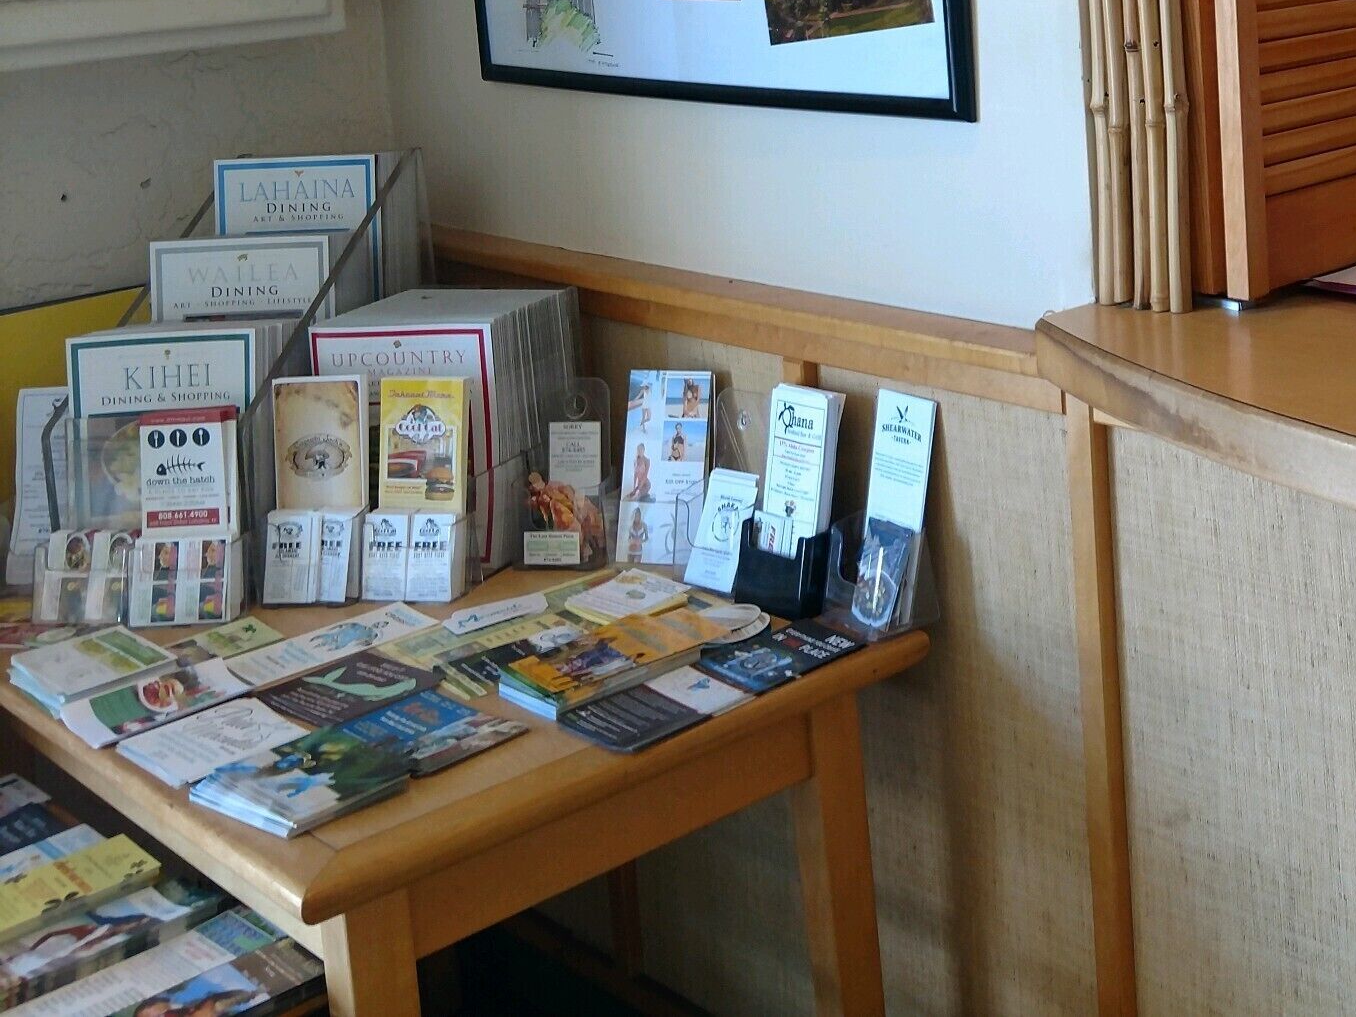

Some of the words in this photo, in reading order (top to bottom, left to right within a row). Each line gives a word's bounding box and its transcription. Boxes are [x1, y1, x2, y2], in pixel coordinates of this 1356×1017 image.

[239, 178, 356, 203] LAHAINA
[266, 201, 332, 214] DINING
[253, 214, 273, 223] ART
[278, 214, 286, 222] &
[290, 213, 345, 221] SHOPPING
[187, 262, 298, 284] WAILEA
[211, 285, 279, 299] DINING
[331, 349, 467, 368] UPCOUNTRY
[122, 362, 211, 391] KIHEI
[100, 394, 152, 407] DINING
[157, 393, 167, 403] &
[171, 390, 231, 402] SHOPPING
[881, 423, 923, 444] SHEARWATER
[146, 478, 170, 486] down
[172, 477, 188, 485] the
[189, 475, 215, 484] hatch
[271, 541, 303, 550] FREE
[368, 540, 403, 552] FREE
[414, 540, 448, 552] FREE
